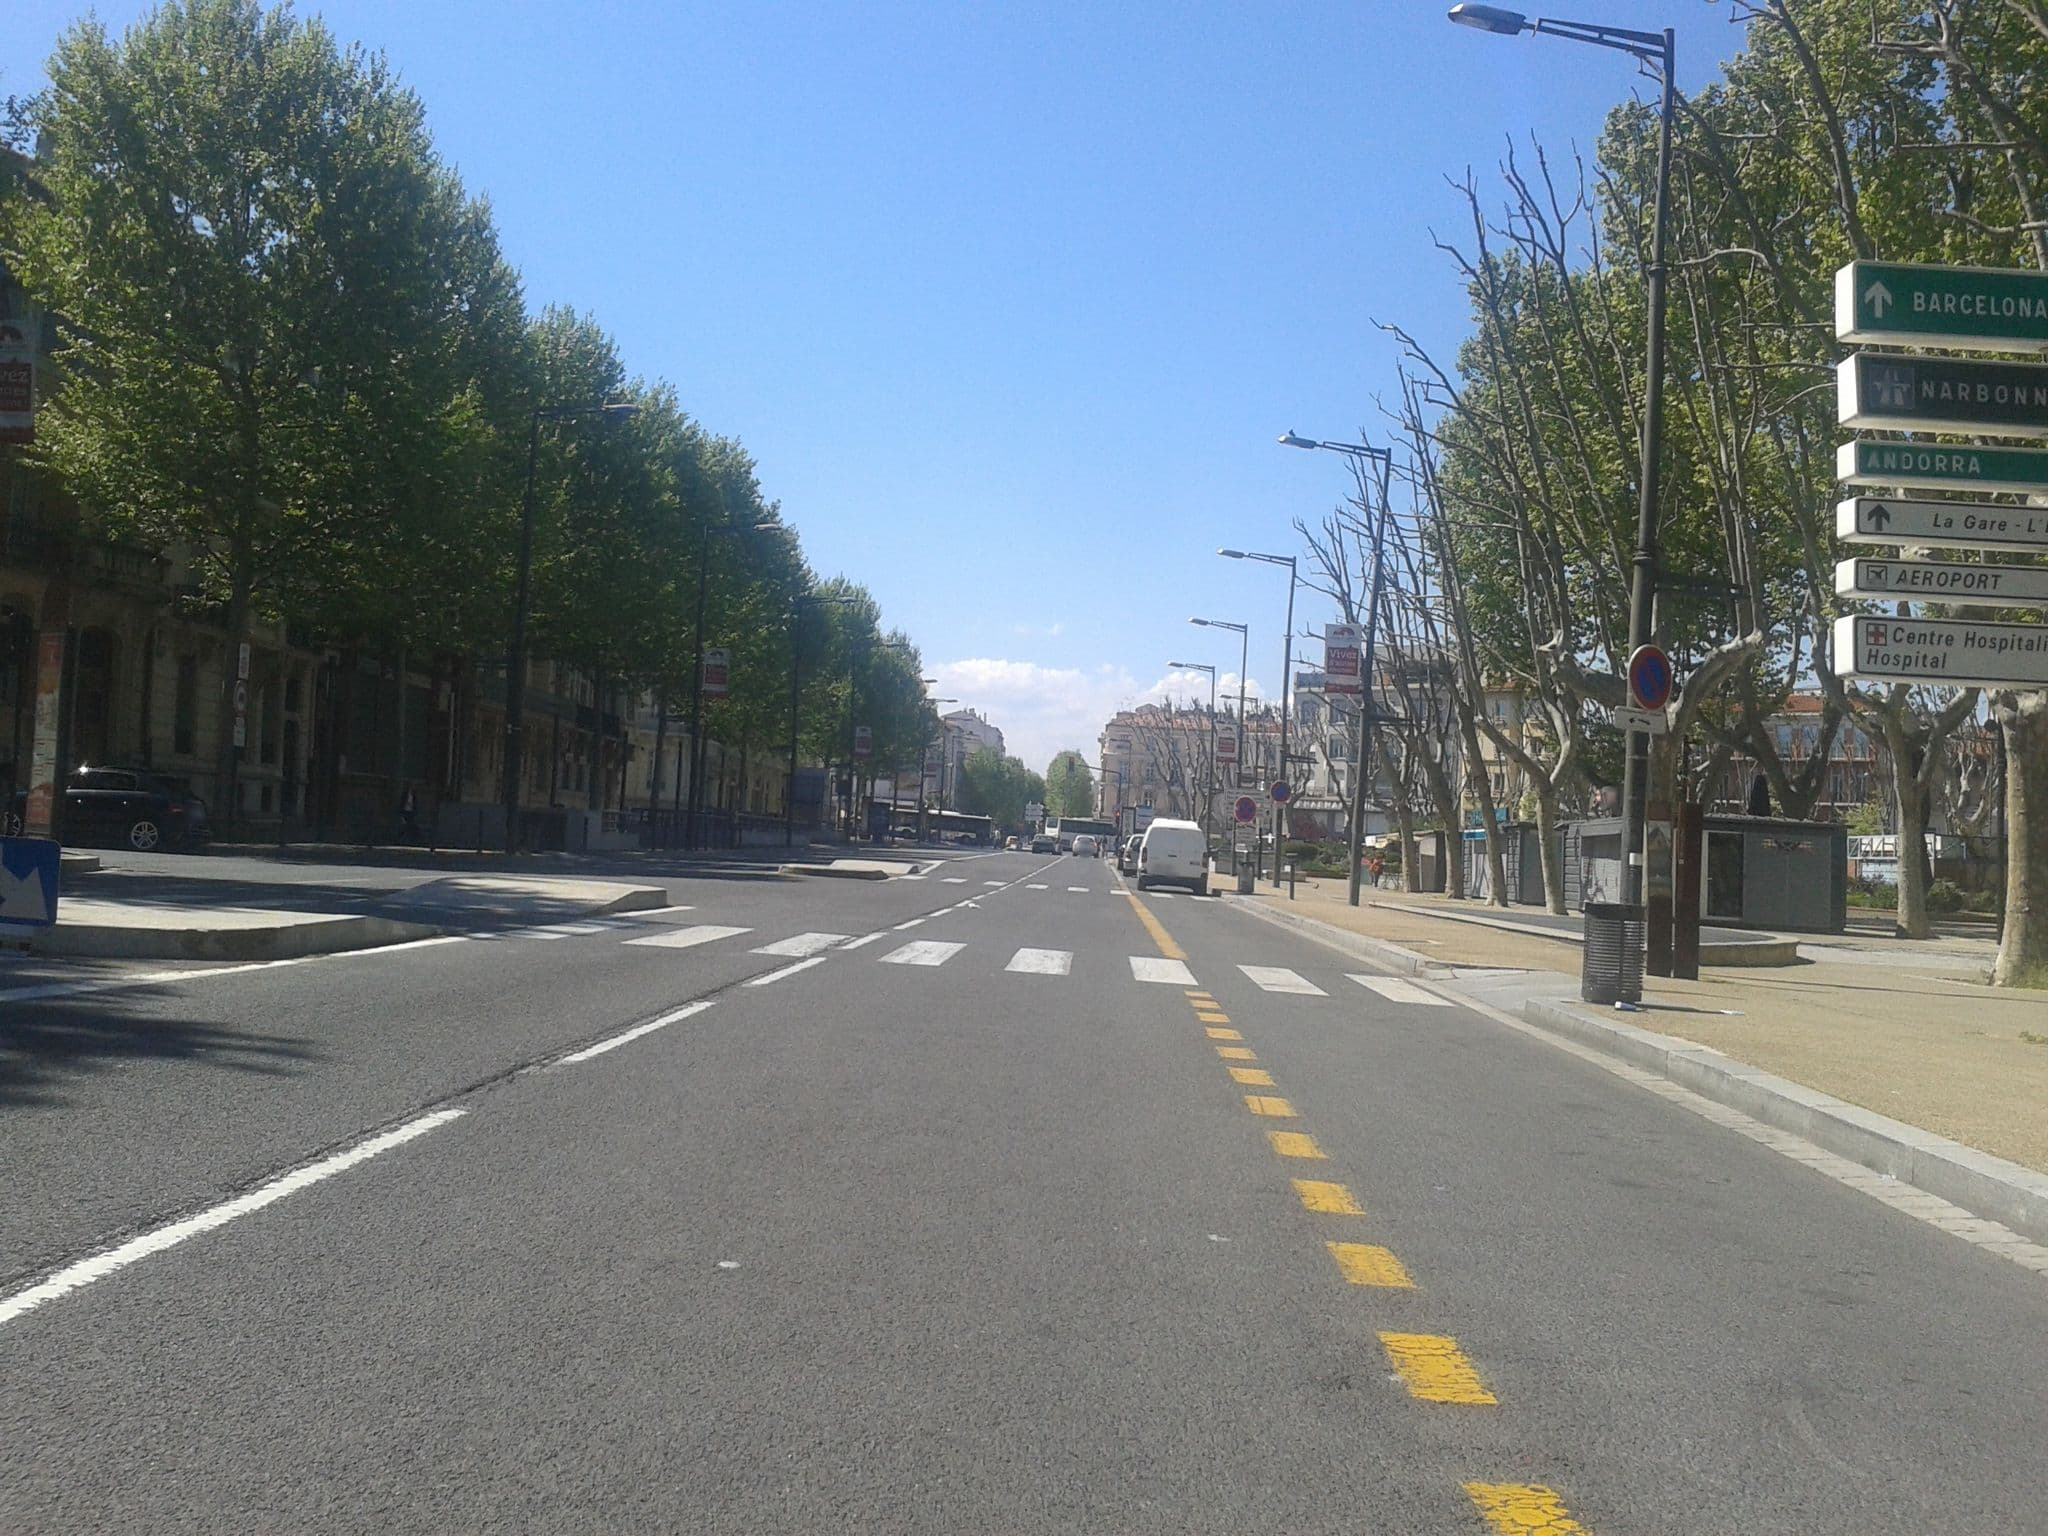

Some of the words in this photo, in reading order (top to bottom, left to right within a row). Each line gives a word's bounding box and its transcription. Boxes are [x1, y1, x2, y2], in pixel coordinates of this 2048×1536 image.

[1913, 291, 2048, 320] BARCELONA
[1867, 450, 1981, 474] ANDORRA
[1932, 512, 1953, 529] La
[1964, 514, 2008, 532] Gare
[1895, 569, 2003, 591] AEROPORT
[1892, 626, 1955, 647] Centre
[1866, 648, 1948, 671] Hospital
